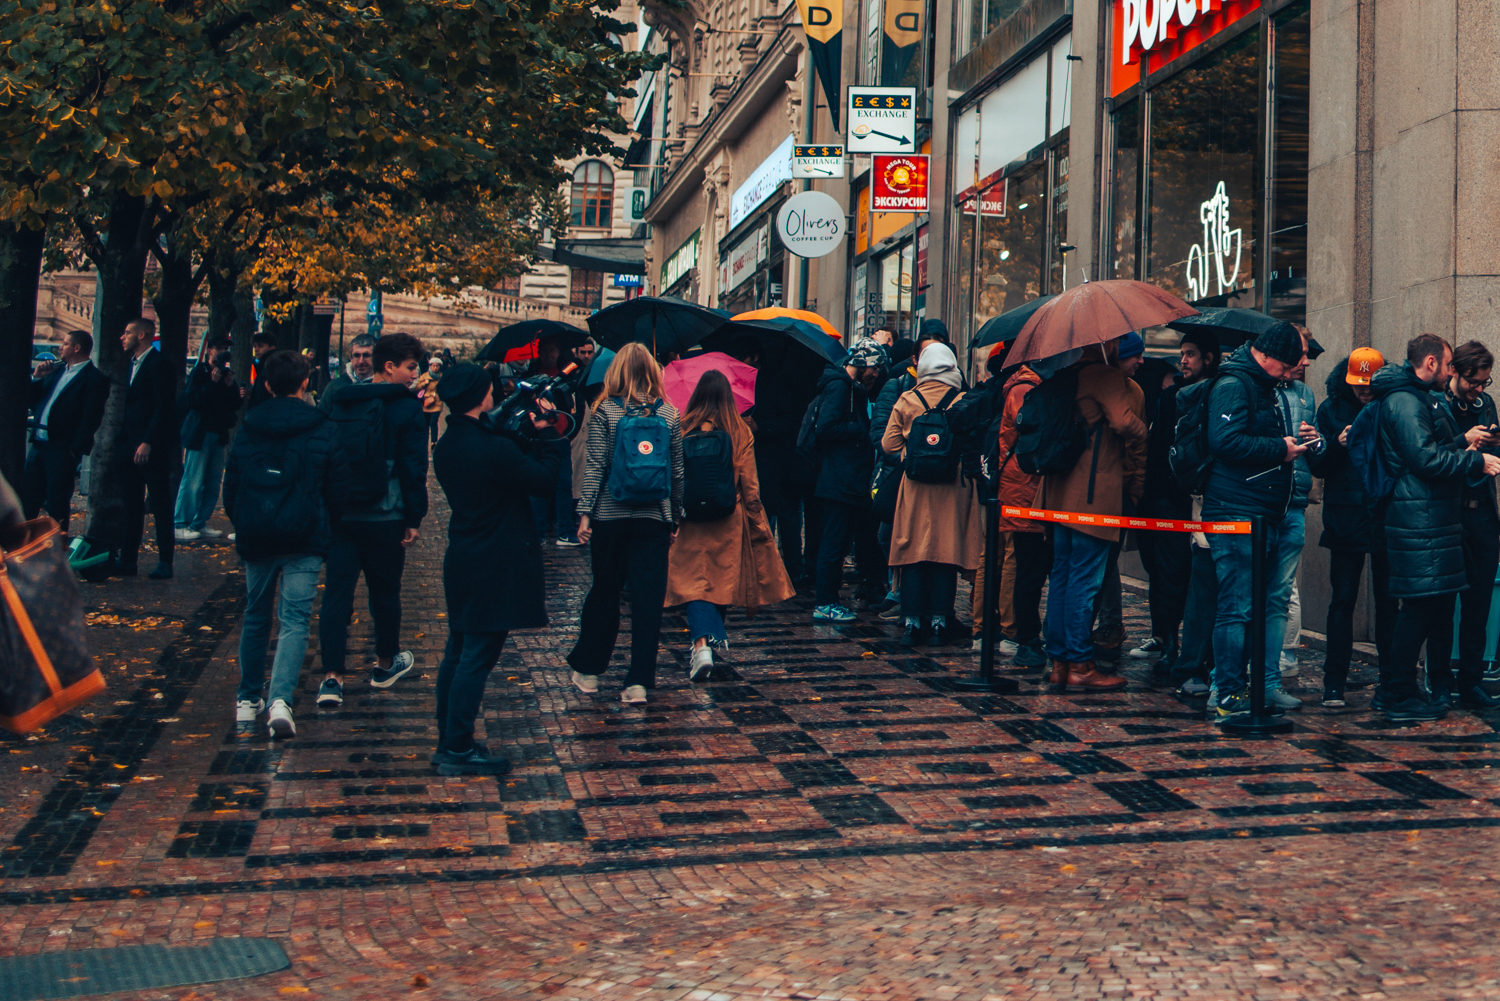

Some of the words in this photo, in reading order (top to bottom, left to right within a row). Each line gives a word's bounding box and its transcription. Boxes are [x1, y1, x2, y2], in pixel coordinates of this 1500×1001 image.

[857, 110, 908, 119] EXCHANGE
[886, 159, 901, 171] MEGA
[902, 158, 917, 171] TOUR
[875, 196, 927, 208] ЭКСКУРСИИ
[785, 209, 839, 237] Olivers
[618, 273, 640, 283] ATM
